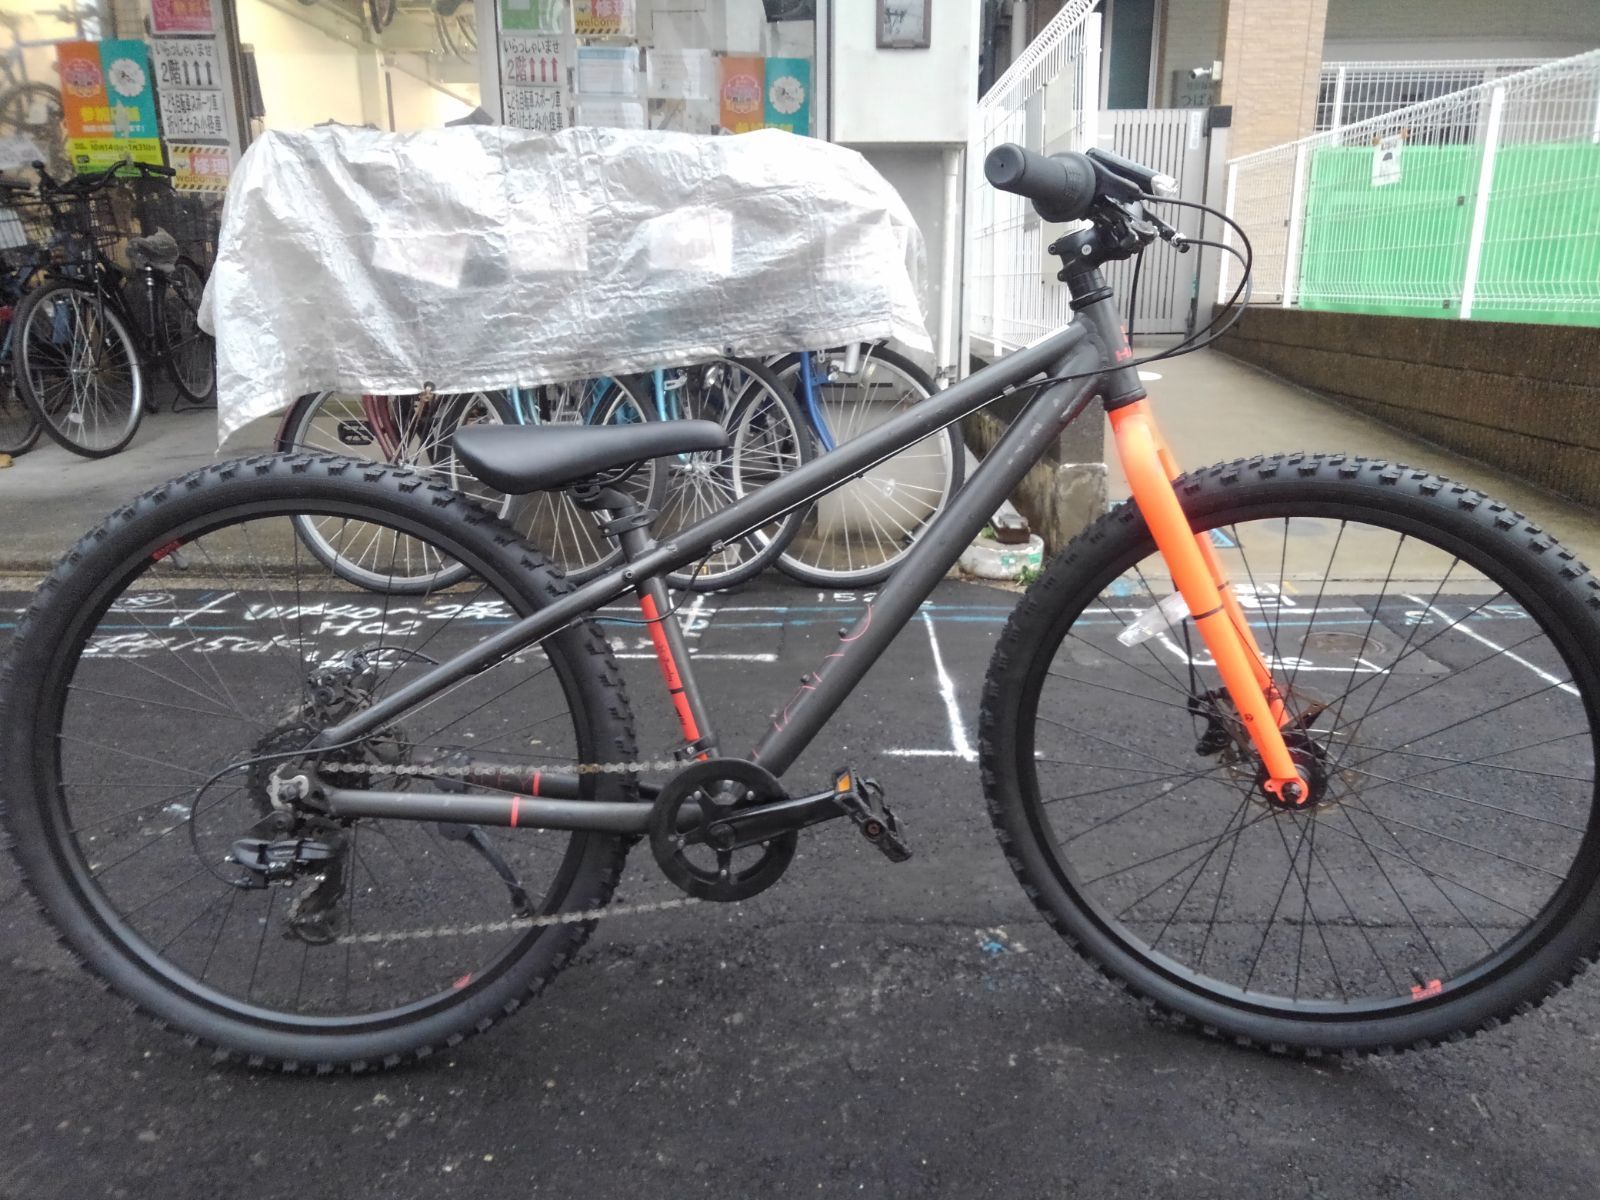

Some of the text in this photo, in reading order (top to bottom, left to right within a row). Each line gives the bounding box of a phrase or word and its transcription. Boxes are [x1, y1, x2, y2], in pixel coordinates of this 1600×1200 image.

[155, 41, 212, 57] いらっしゃいませ
[503, 39, 560, 53] いらっしゃいませ
[175, 174, 226, 184] welcome
